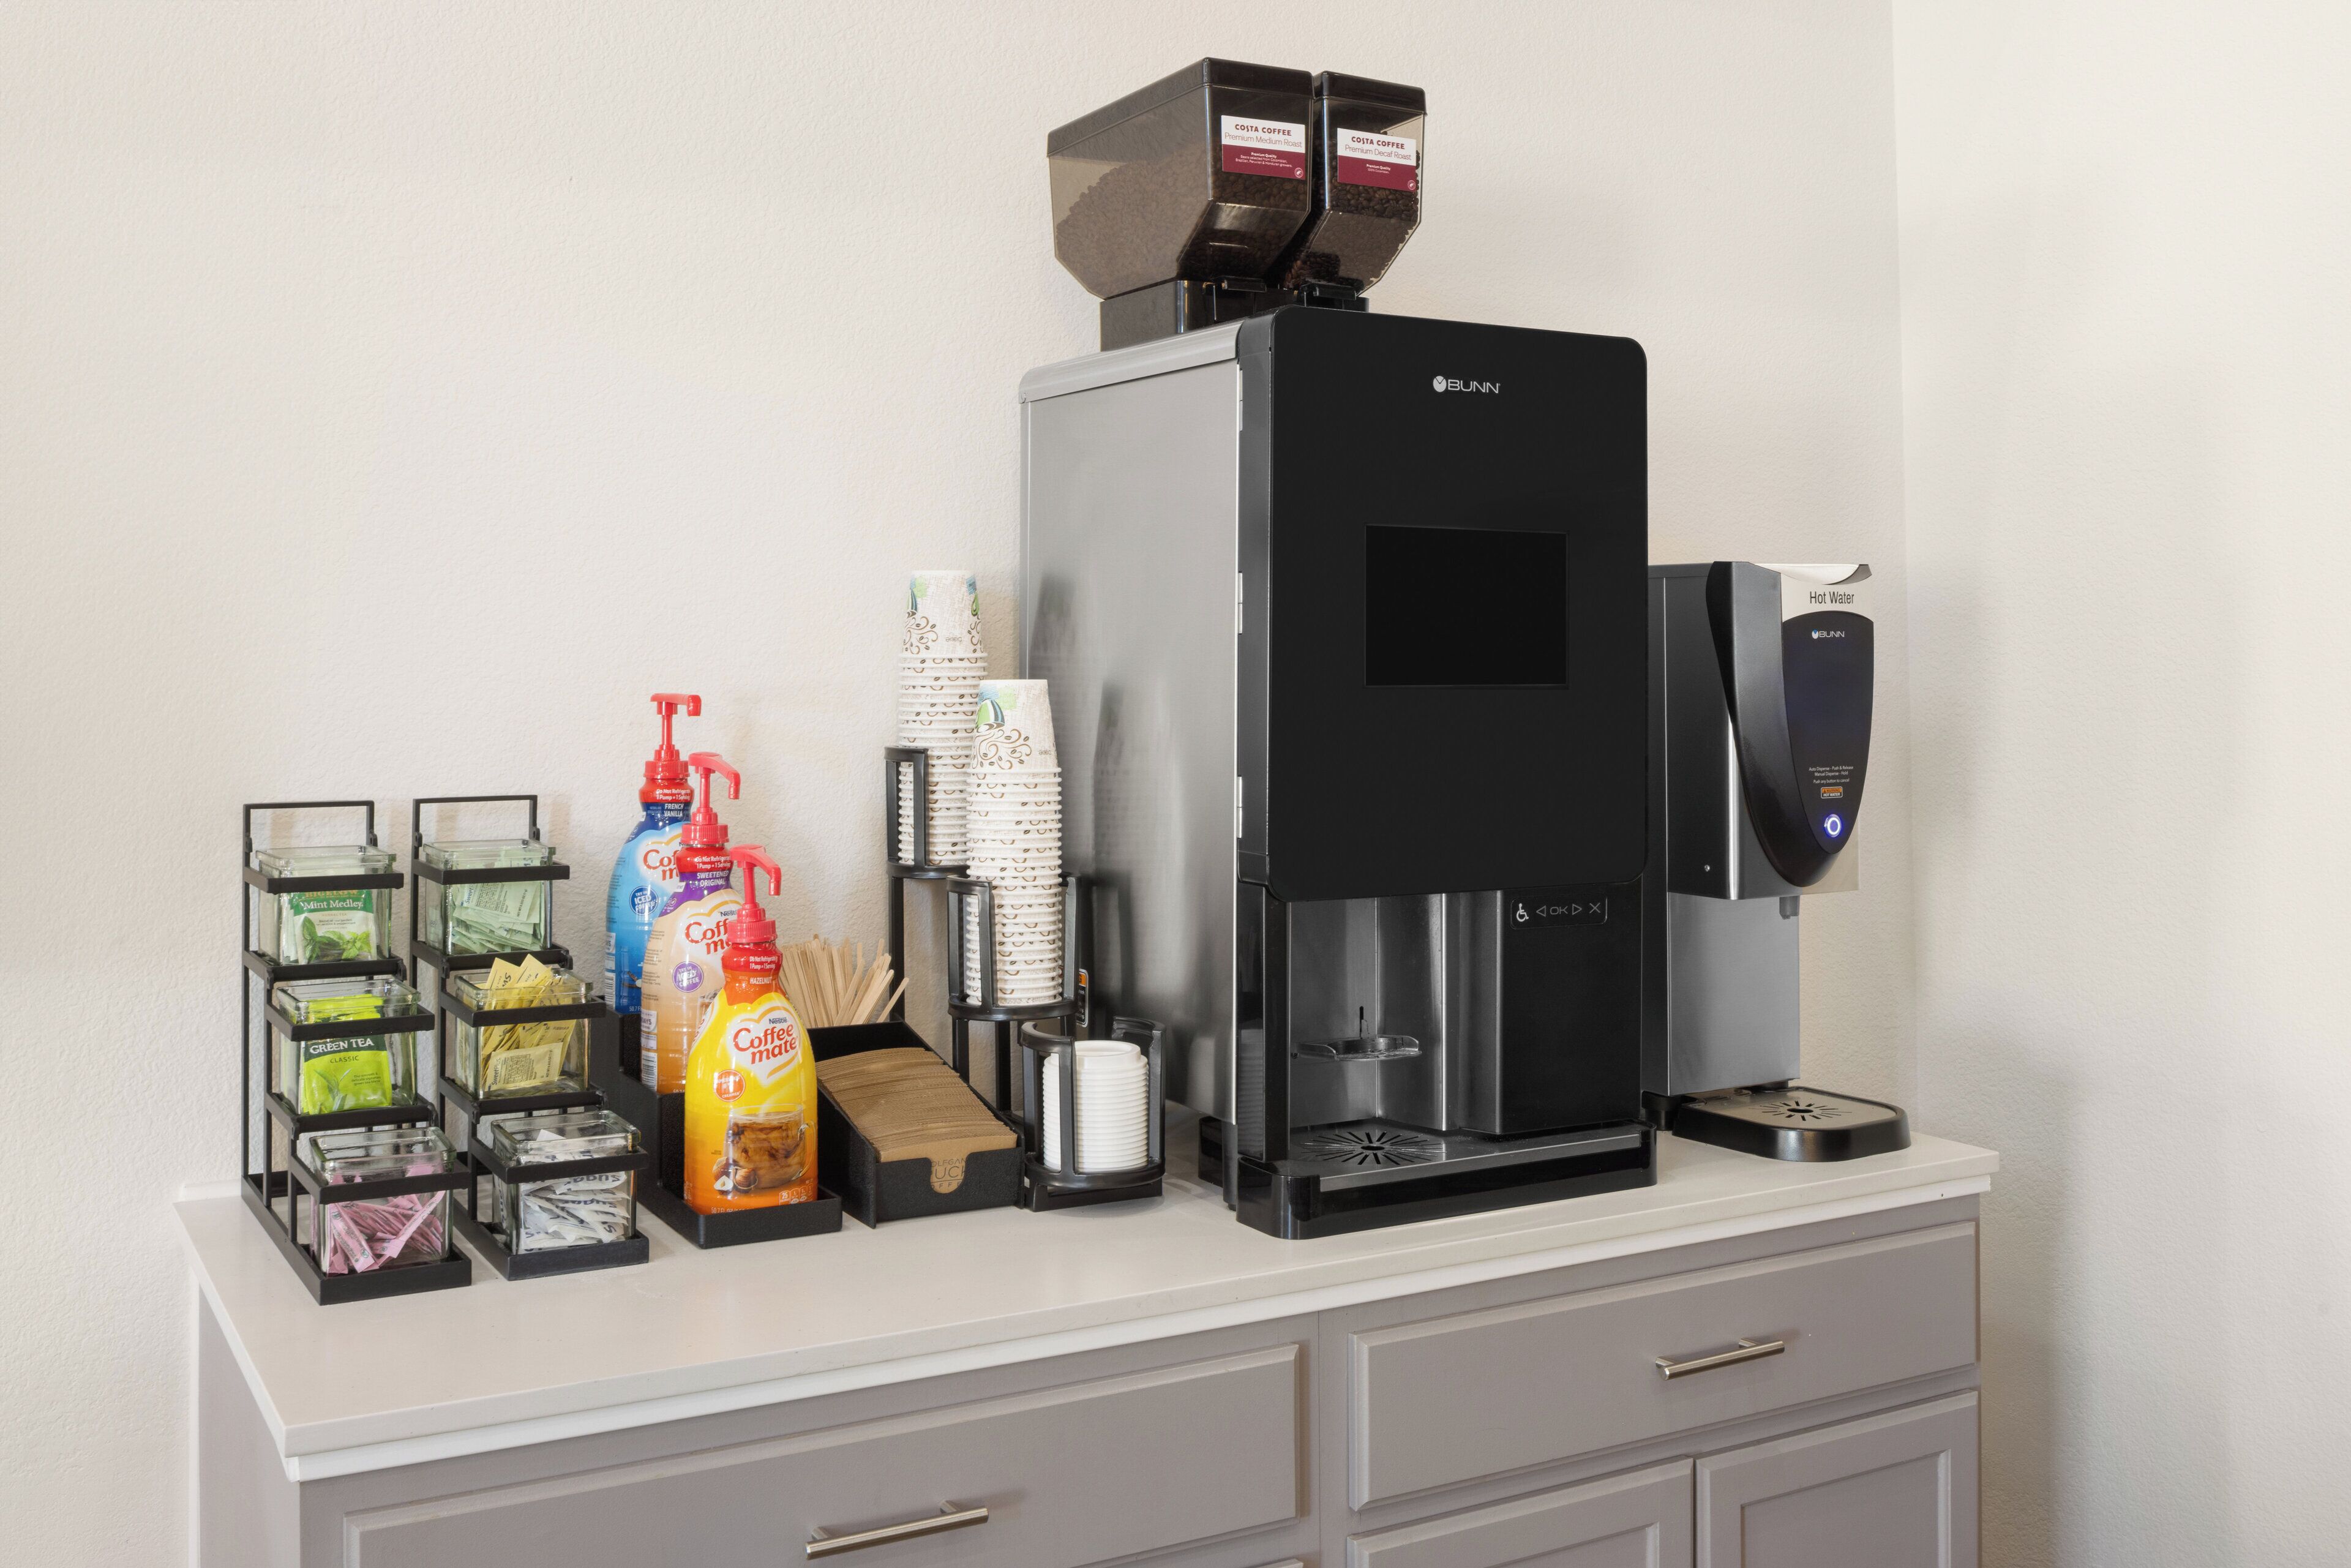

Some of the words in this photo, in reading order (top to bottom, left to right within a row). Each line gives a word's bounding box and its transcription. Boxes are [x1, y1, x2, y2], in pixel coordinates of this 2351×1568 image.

[1235, 124, 1259, 132] COSTA
[1261, 127, 1292, 136] COFFEE
[1224, 132, 1254, 142] Premium
[1256, 136, 1282, 145] Medium
[1283, 138, 1303, 148] Roast
[1351, 136, 1374, 145] COSTA
[1376, 140, 1405, 149] COFFEE
[1345, 144, 1373, 155] Premium
[1374, 148, 1393, 157] Decaf
[1394, 151, 1411, 160] Roast
[1448, 379, 1499, 394] BUNN
[1810, 591, 1826, 604] Hot
[1829, 591, 1854, 604] Water
[697, 870, 729, 879] SWEETENED
[700, 878, 726, 887] ORIGINAL
[304, 901, 328, 910] Mint
[634, 895, 651, 905] ICED
[1550, 906, 1569, 915] OK
[685, 918, 729, 944] Coff
[733, 1024, 793, 1052] Coffee
[309, 1039, 348, 1054] GREEN
[350, 1037, 375, 1048] TEA
[751, 1035, 798, 1065] mate
[329, 1055, 359, 1064] CLASSIC
[931, 1158, 966, 1168] OLFGAN
